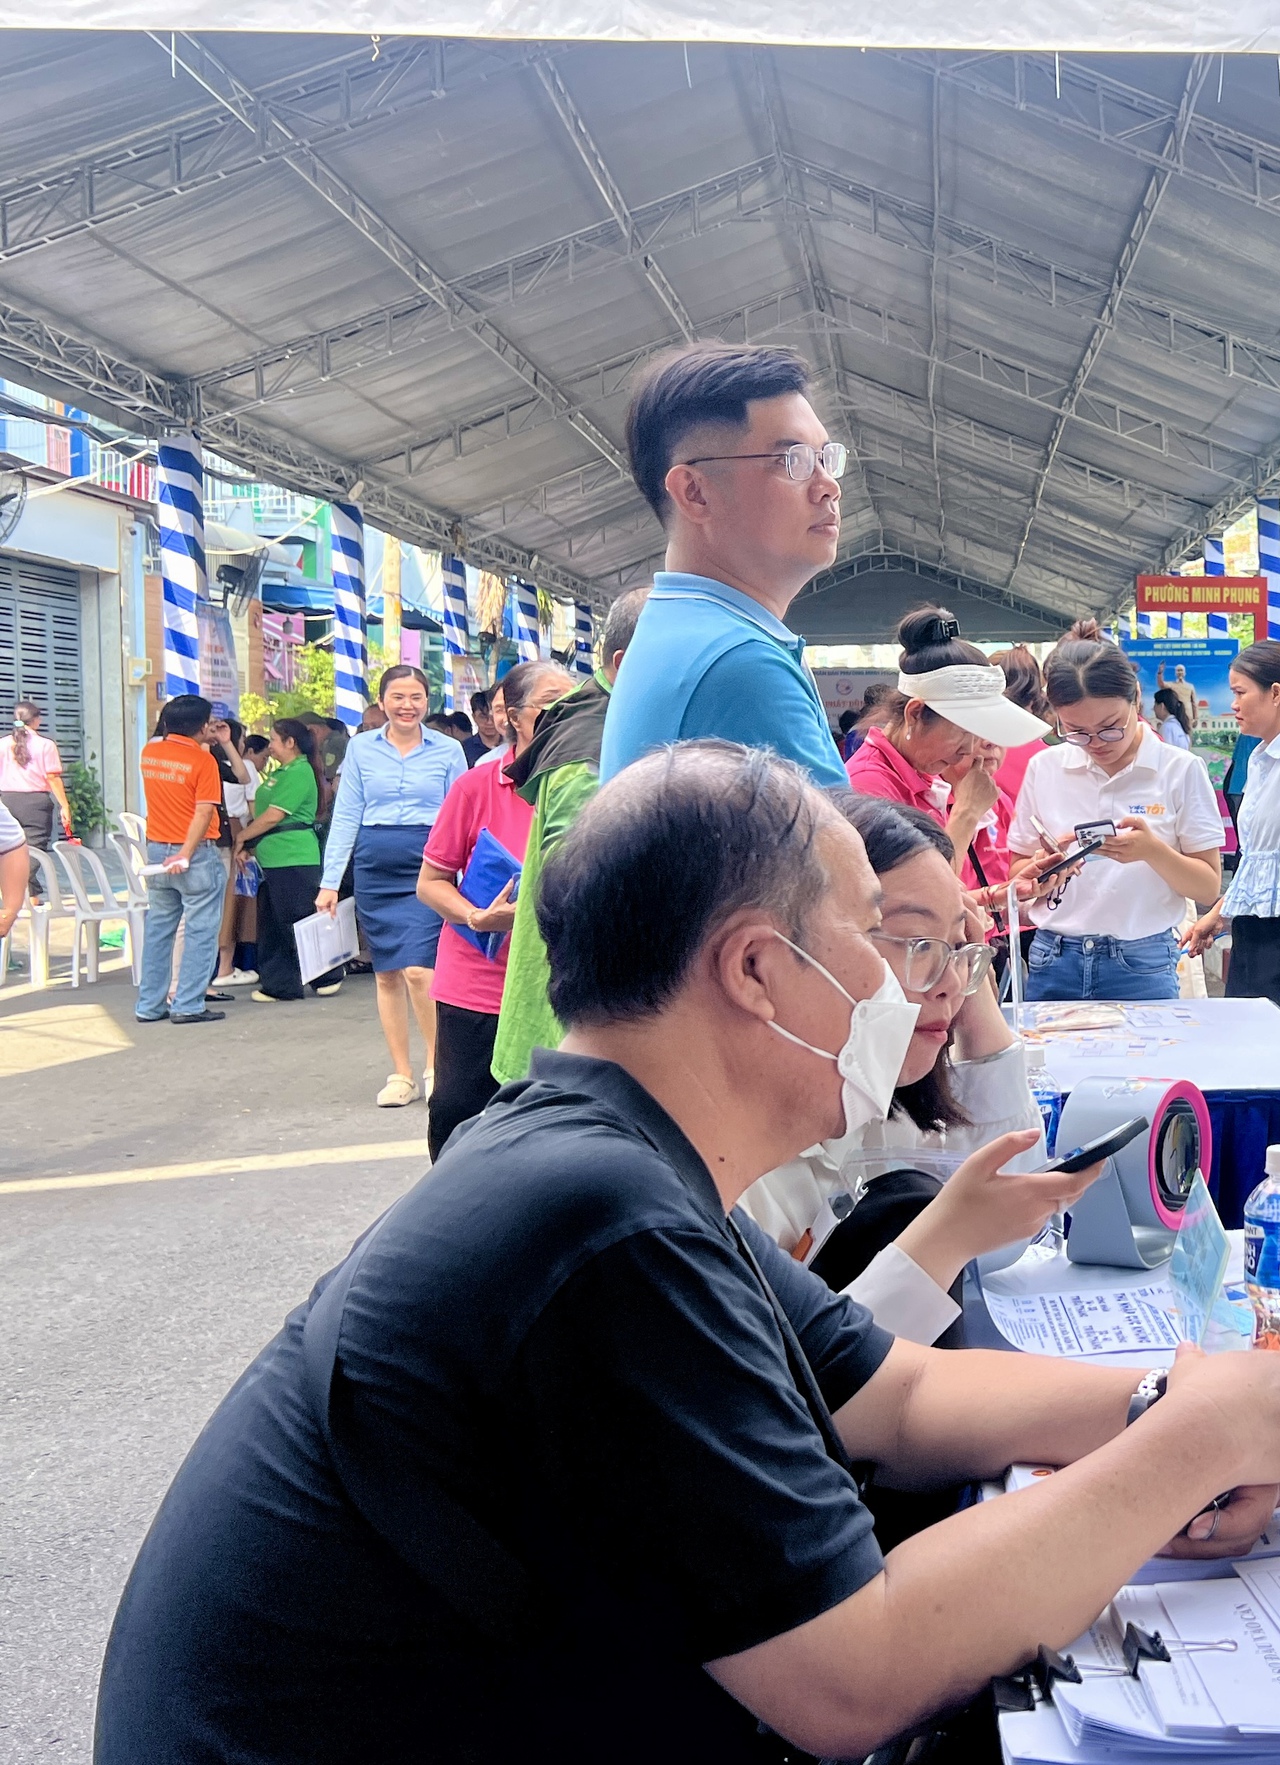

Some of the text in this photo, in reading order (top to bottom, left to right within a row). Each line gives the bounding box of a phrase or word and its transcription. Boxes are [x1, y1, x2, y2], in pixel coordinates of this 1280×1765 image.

[1145, 583, 1260, 607] PHƯỜNG MINH PHỤNG
